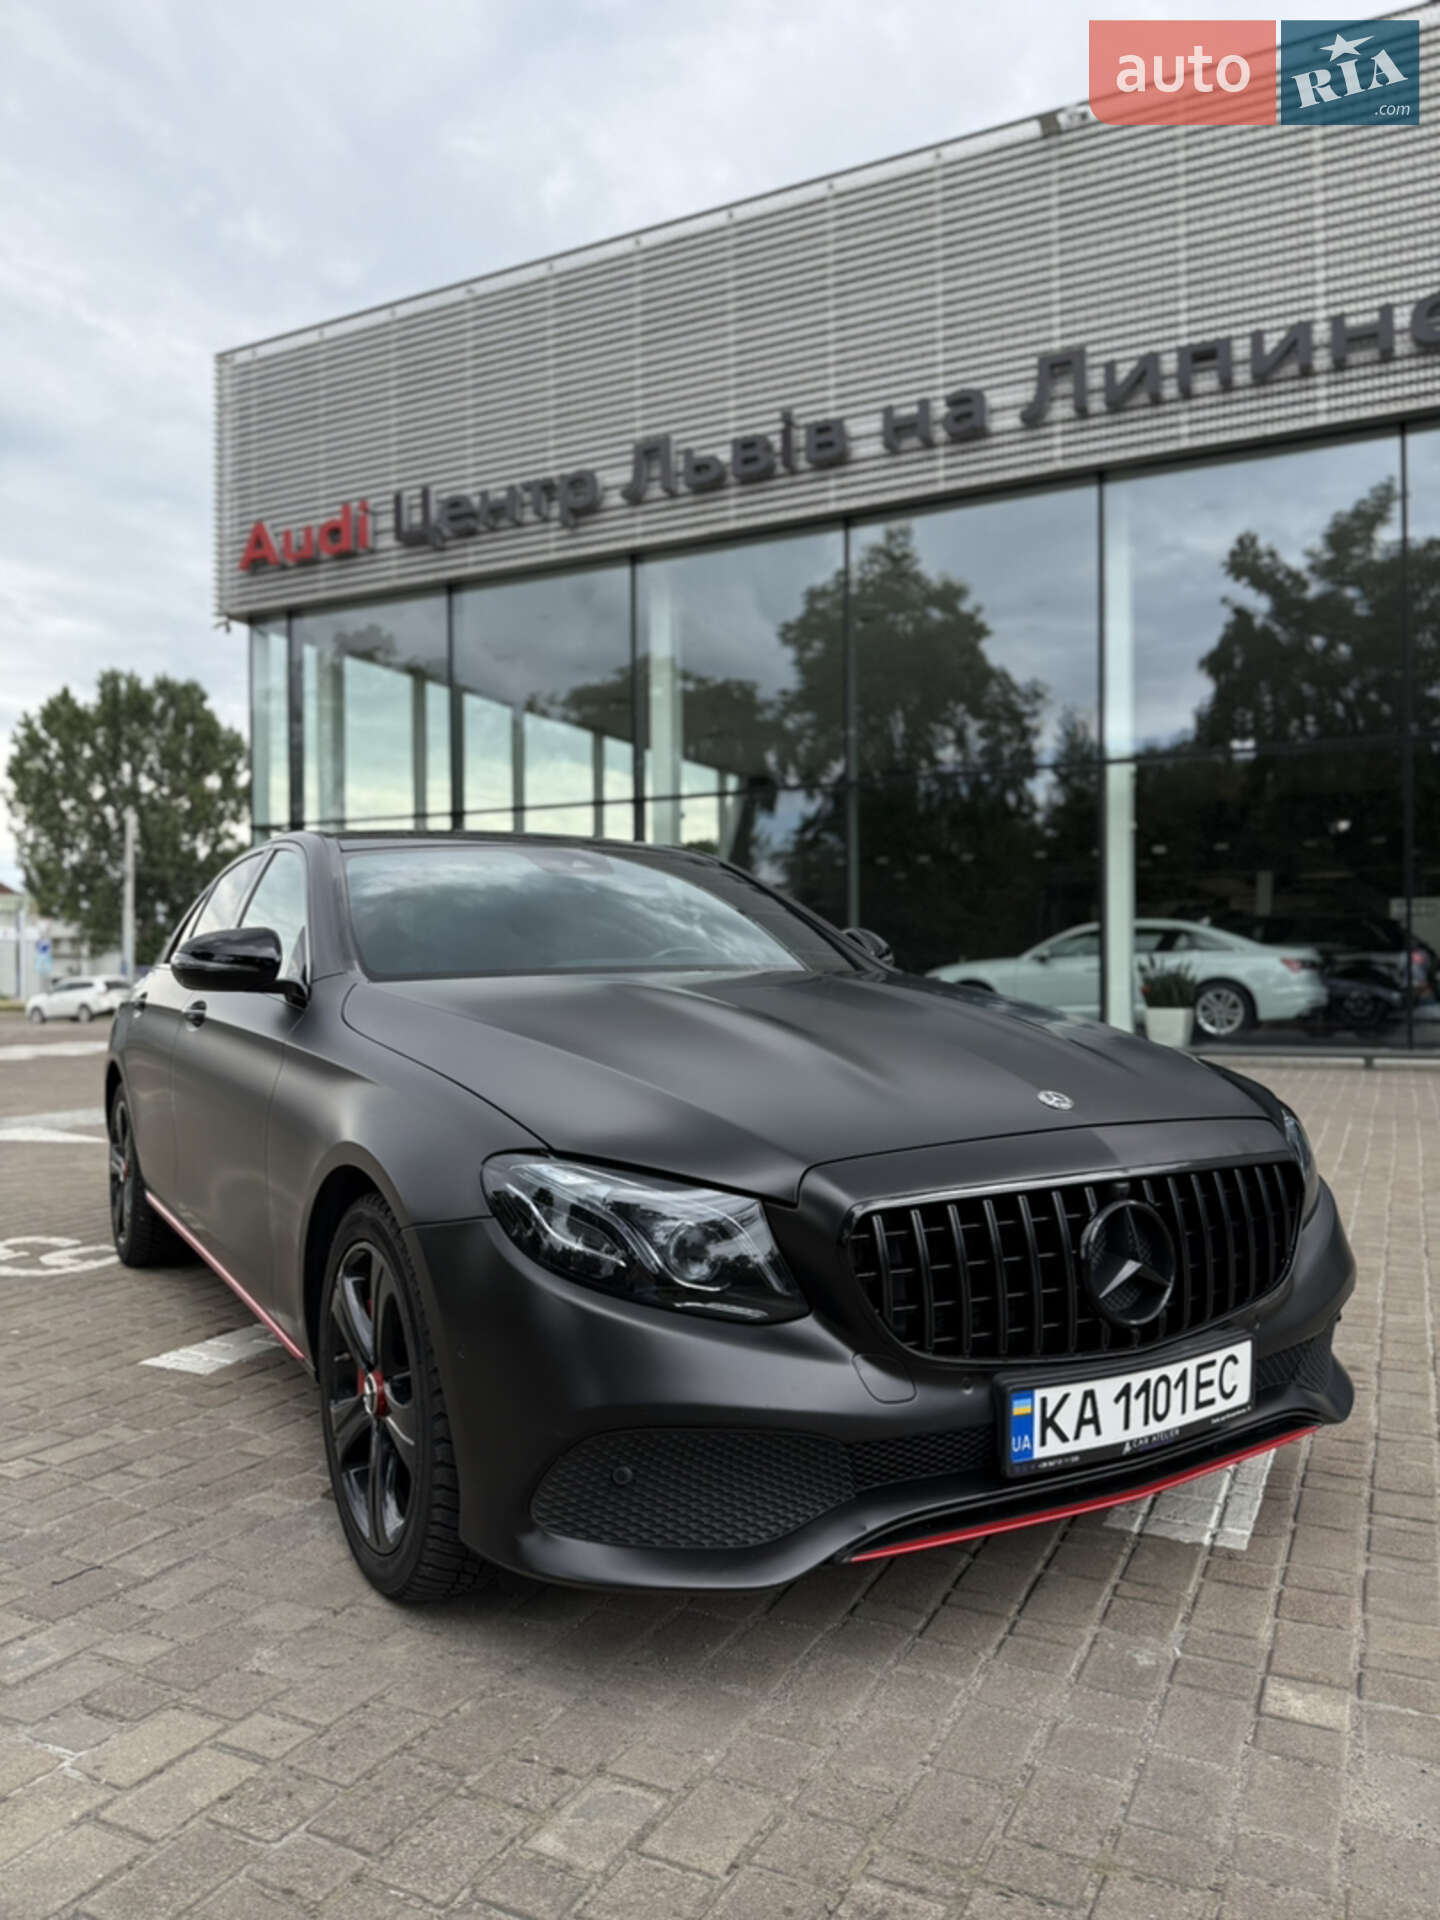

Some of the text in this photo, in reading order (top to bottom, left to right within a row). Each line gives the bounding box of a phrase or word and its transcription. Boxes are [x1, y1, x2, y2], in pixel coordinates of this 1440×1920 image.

[239, 499, 371, 573] Audi
[394, 470, 601, 549] Центр
[620, 408, 848, 504] Львів
[882, 387, 990, 456] на
[1011, 1434, 1032, 1453] UA
[1038, 1388, 1103, 1448] KA
